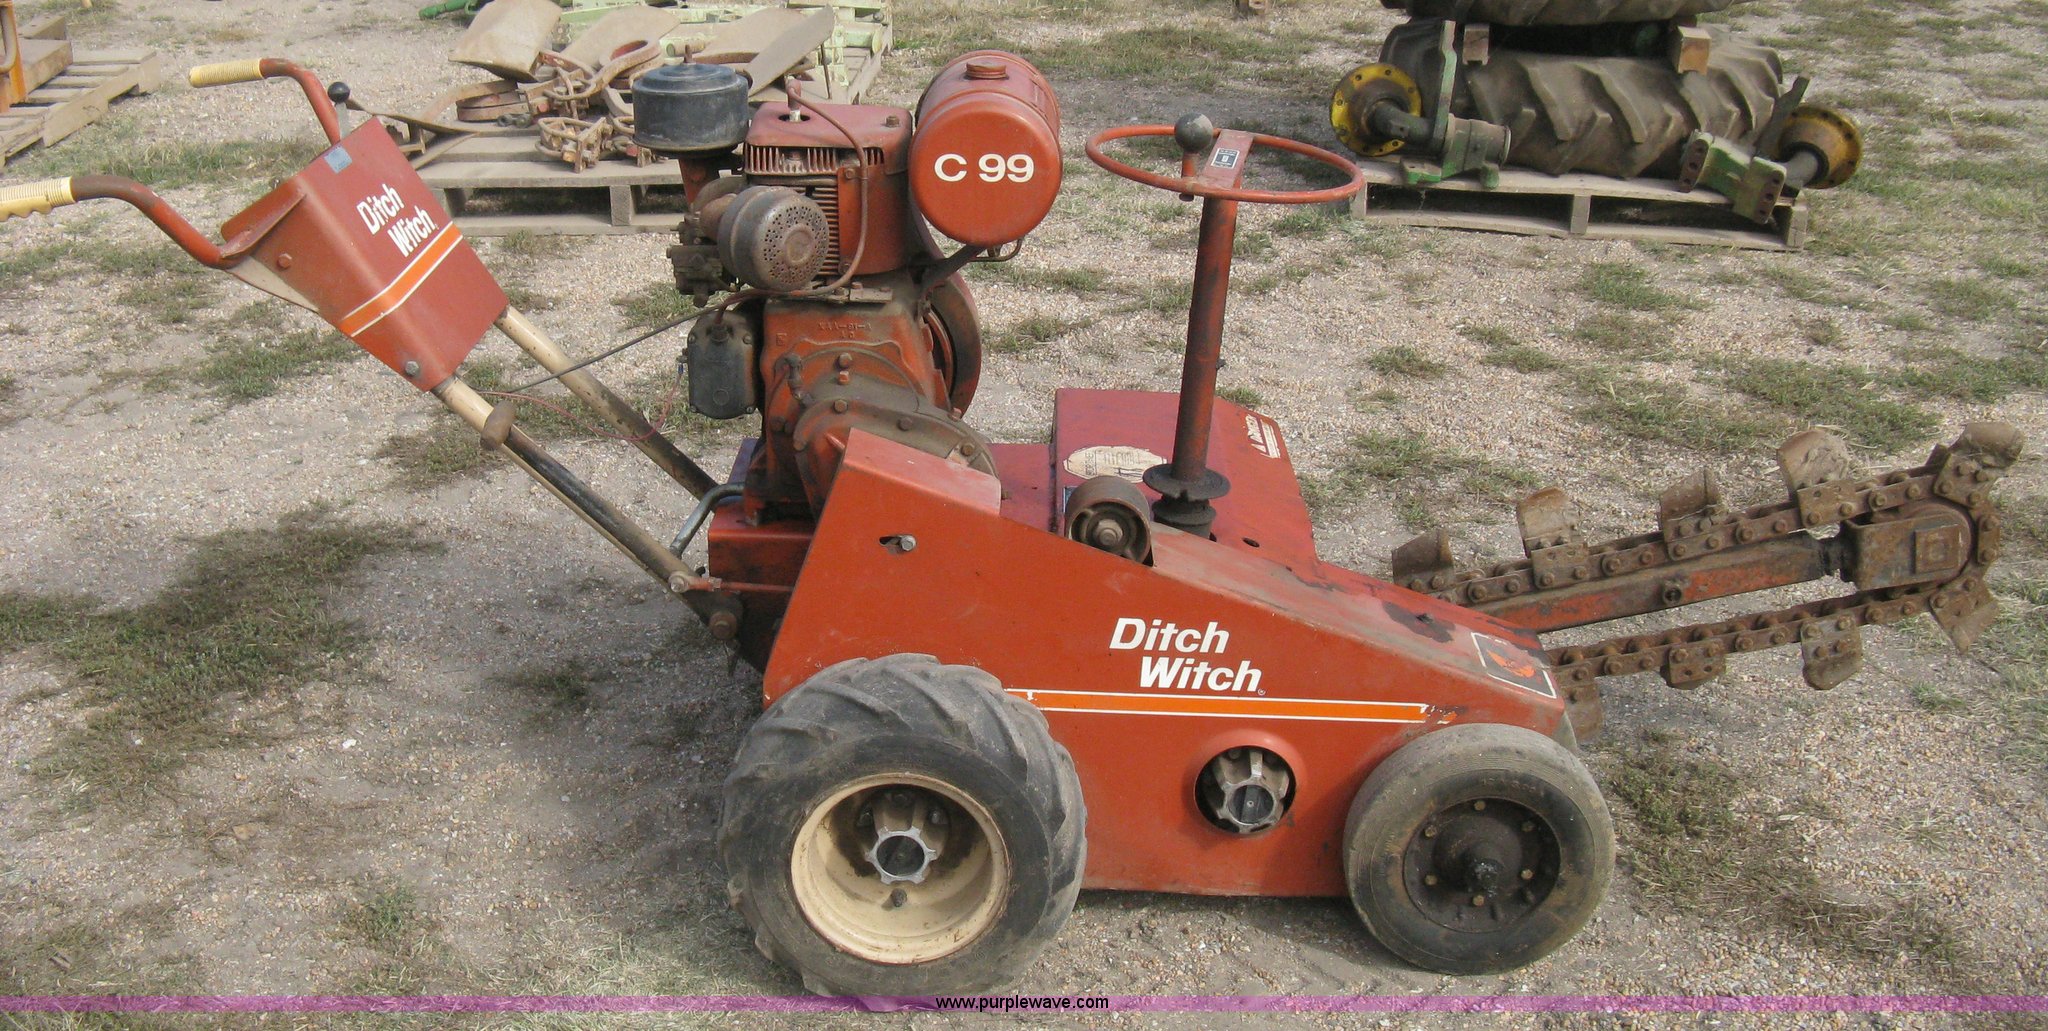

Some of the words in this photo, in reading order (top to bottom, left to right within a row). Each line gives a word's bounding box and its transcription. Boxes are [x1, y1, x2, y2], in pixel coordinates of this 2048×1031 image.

[934, 153, 968, 182] C
[978, 153, 1035, 183] 99
[356, 183, 405, 235] Ditch
[387, 205, 437, 258] Witch
[1109, 617, 1230, 654] Ditch
[1140, 656, 1263, 692] Witch
